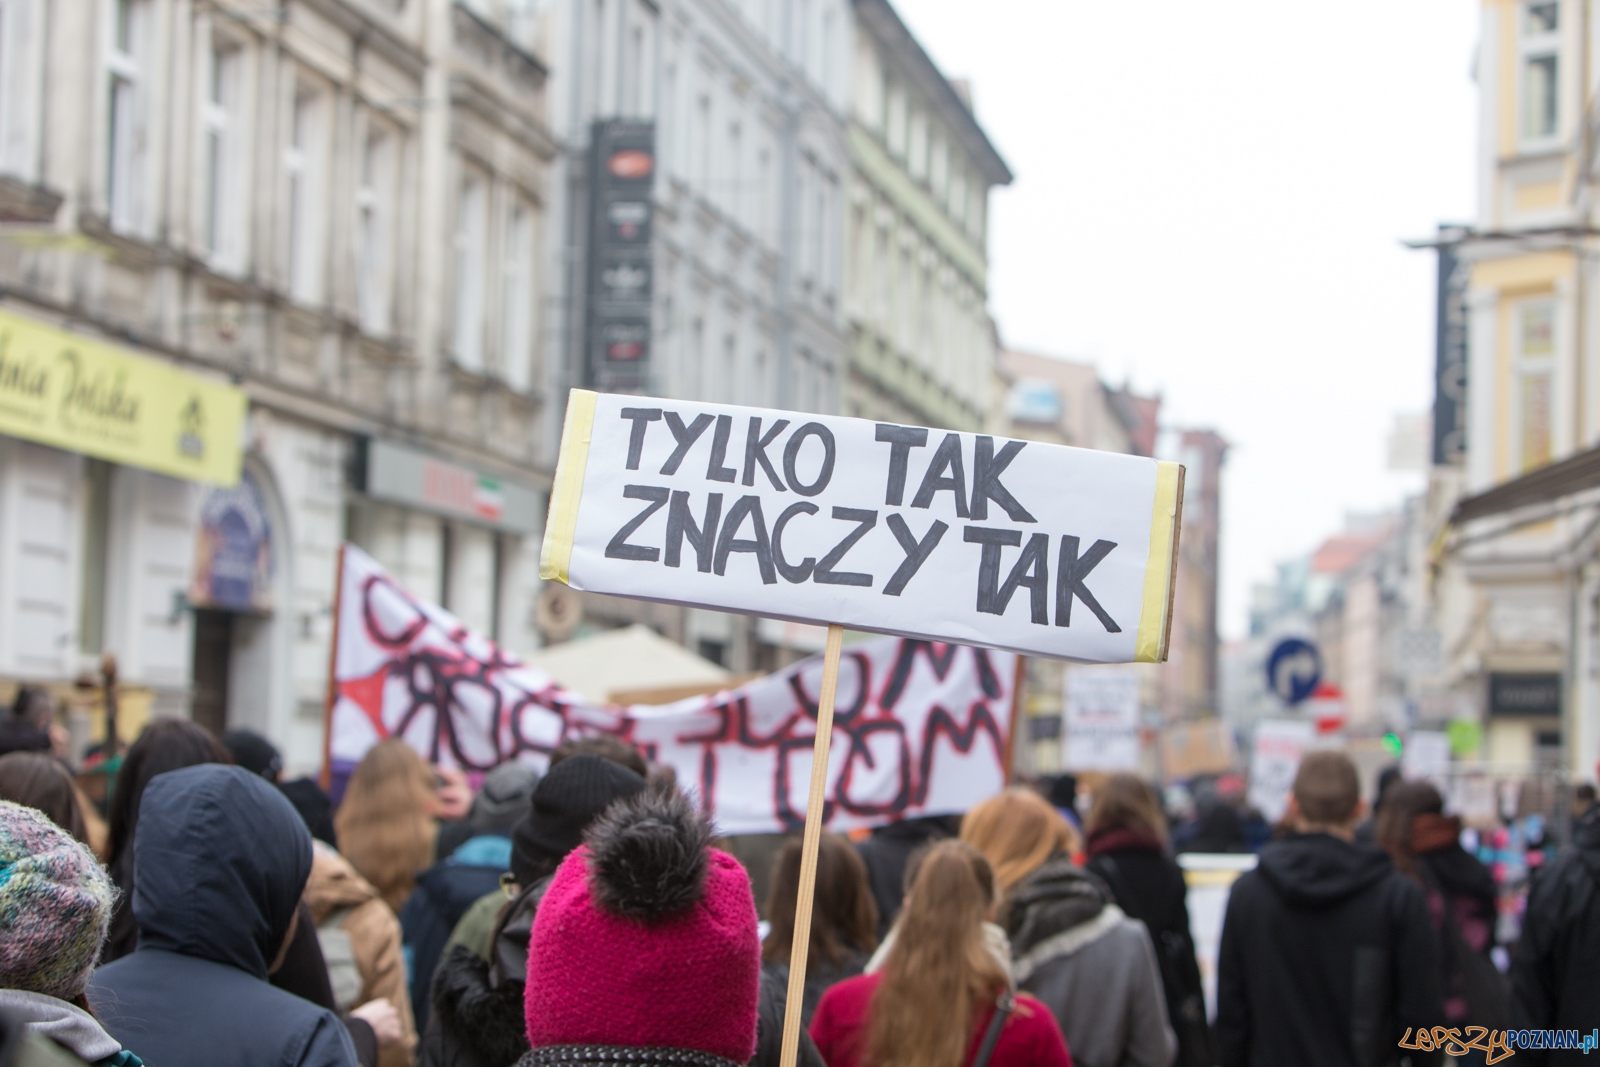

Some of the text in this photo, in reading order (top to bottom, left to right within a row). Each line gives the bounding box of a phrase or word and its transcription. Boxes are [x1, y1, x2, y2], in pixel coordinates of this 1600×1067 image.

[621, 407, 1038, 523] TYLKO TAK
[604, 484, 949, 597] ZNACZY
[963, 525, 1122, 634] TAK
